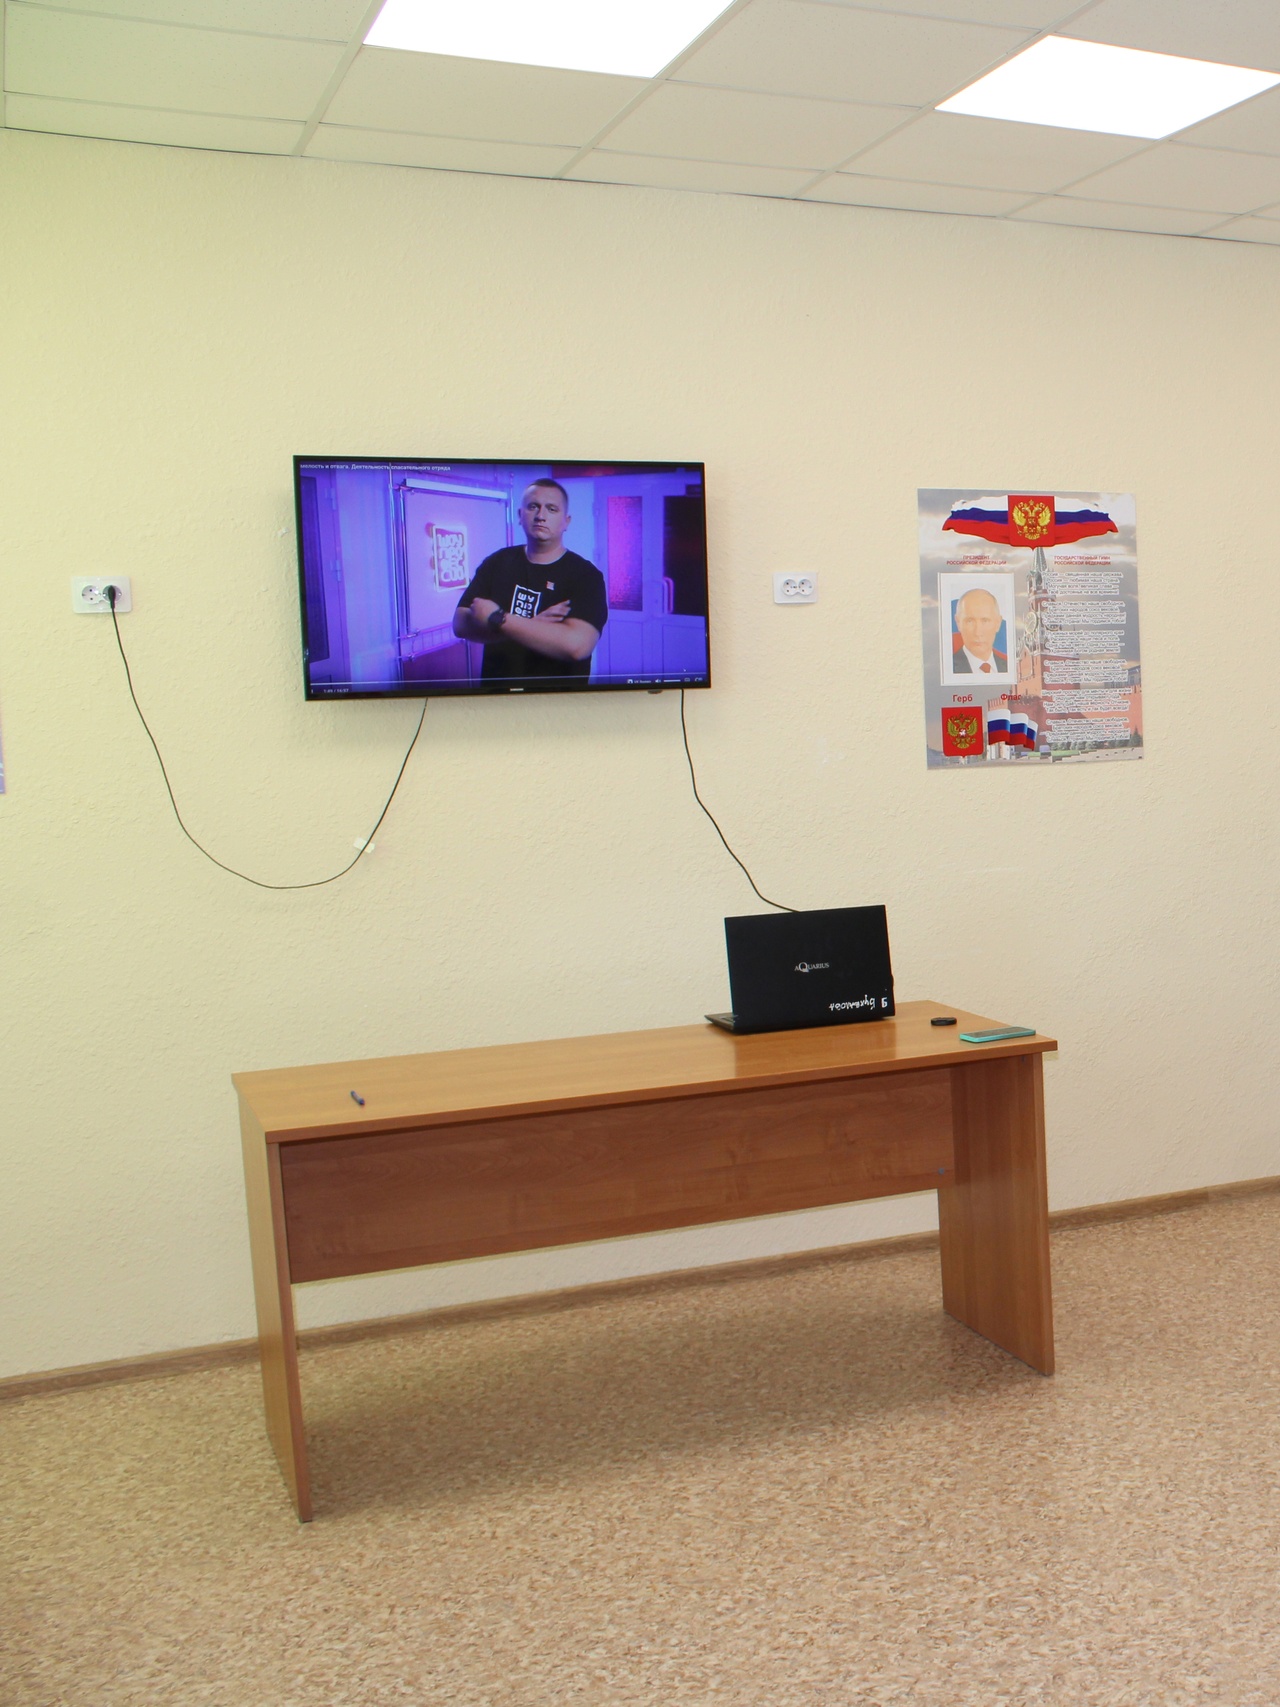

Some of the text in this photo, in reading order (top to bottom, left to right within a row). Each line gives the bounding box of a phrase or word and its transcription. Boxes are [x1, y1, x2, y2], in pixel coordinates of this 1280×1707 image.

[952, 694, 973, 703] Герб
[1000, 693, 1021, 701] Флаг
[794, 962, 830, 973] AQUARIUS
